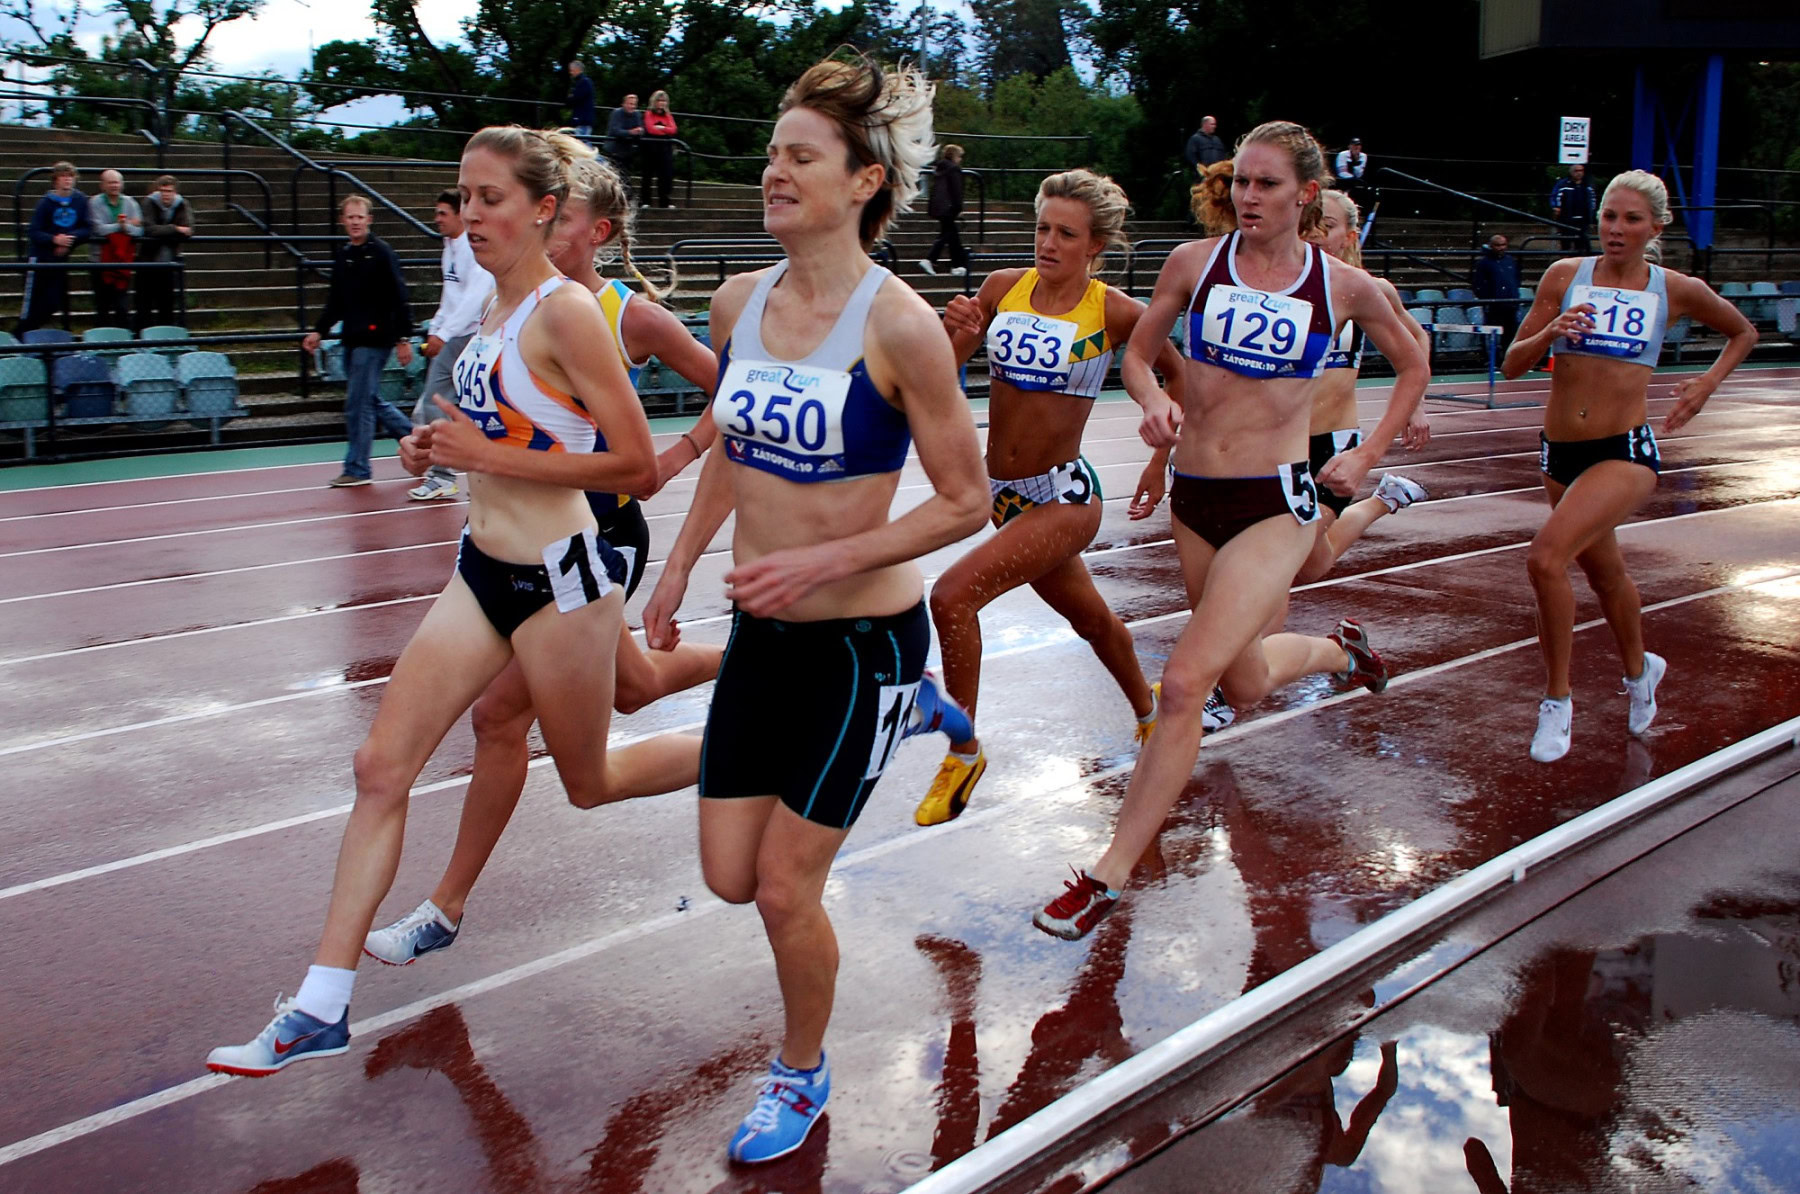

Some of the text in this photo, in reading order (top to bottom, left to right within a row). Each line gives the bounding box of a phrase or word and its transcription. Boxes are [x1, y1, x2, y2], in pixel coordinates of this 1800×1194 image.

[1564, 122, 1587, 132] DRY
[1229, 291, 1259, 305] great
[1006, 316, 1031, 326] great
[1216, 307, 1297, 355] 129
[994, 329, 1062, 369] 353
[457, 360, 486, 408] 345
[746, 369, 820, 388] great run
[728, 390, 826, 451] 350
[1290, 461, 1316, 521] 5
[558, 532, 600, 604] 1
